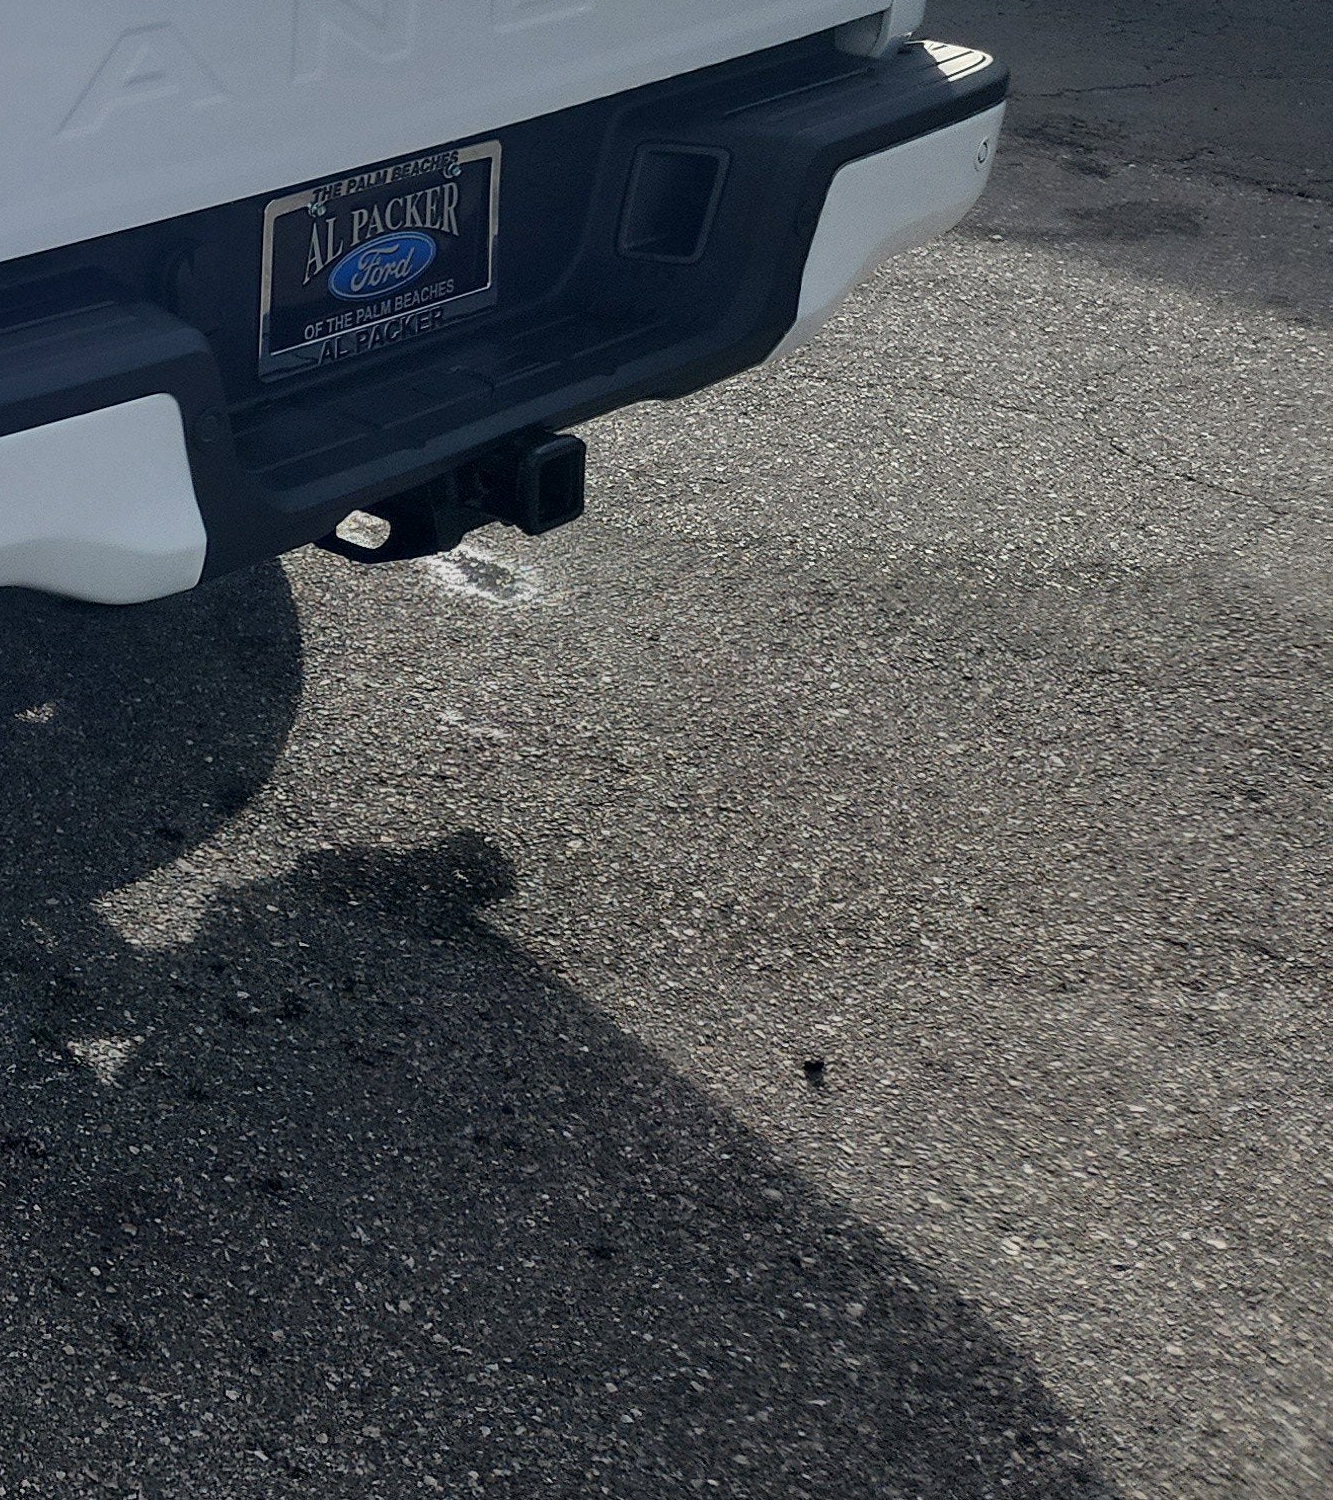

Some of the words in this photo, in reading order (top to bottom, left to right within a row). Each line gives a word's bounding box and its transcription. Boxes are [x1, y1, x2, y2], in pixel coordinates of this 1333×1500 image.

[312, 182, 342, 203] THE
[346, 169, 389, 193] PALM
[391, 150, 460, 182] BEACHES
[302, 217, 344, 285] AL
[351, 183, 460, 244] PACKER
[350, 243, 415, 292] Ford
[304, 321, 324, 340] OF
[326, 312, 353, 332] THE
[356, 300, 392, 324] PALM
[394, 278, 455, 312] BEACHES
[317, 336, 348, 366] AL
[355, 306, 444, 350] PACKER
